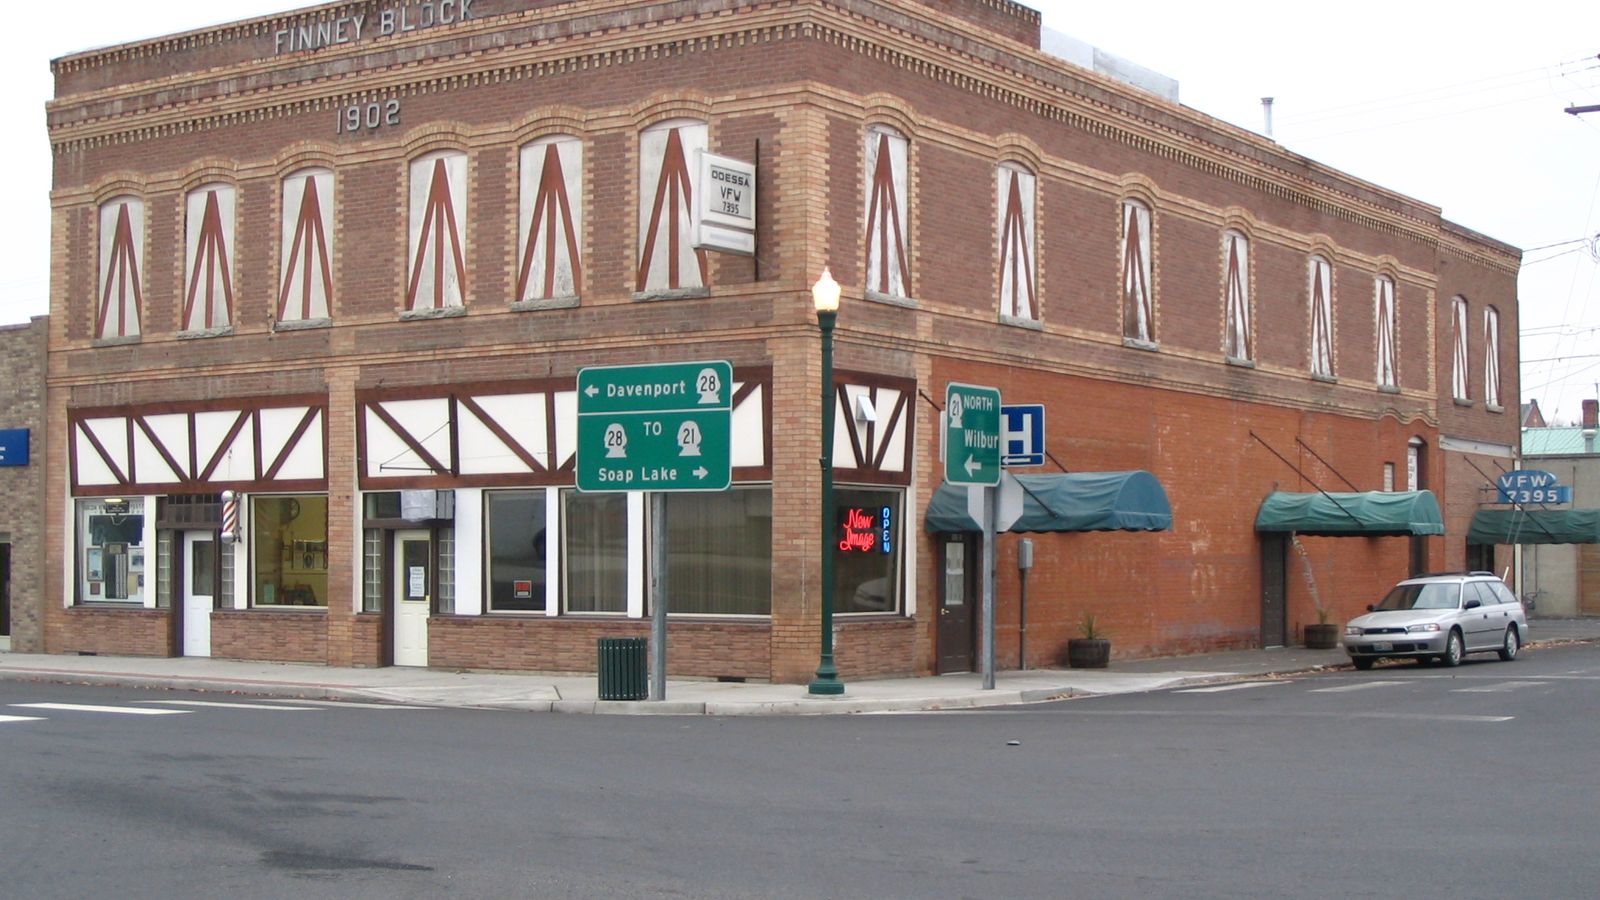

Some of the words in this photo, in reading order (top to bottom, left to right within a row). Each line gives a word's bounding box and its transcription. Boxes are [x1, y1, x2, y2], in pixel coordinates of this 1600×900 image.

[275, 14, 365, 54] FINNEY
[380, 0, 473, 36] BLOCK
[337, 99, 400, 134] 1902
[711, 170, 750, 187] ODESSA
[720, 186, 741, 202] VFW
[722, 201, 739, 214] 7395
[607, 380, 685, 398] Davenport
[700, 375, 716, 392] 28
[952, 400, 960, 416] 21
[963, 395, 993, 412] NORTH
[643, 421, 662, 436] TO
[683, 428, 695, 445] 21
[1001, 413, 1032, 455] H
[608, 430, 623, 447] 28
[964, 429, 999, 449] Wilbur
[598, 467, 634, 484] Soap
[641, 466, 678, 482] Lake
[1501, 475, 1547, 488] VFW
[1506, 489, 1558, 503] 7395
[842, 508, 875, 529] New
[882, 507, 890, 553] OPEN
[839, 527, 876, 552] Image
